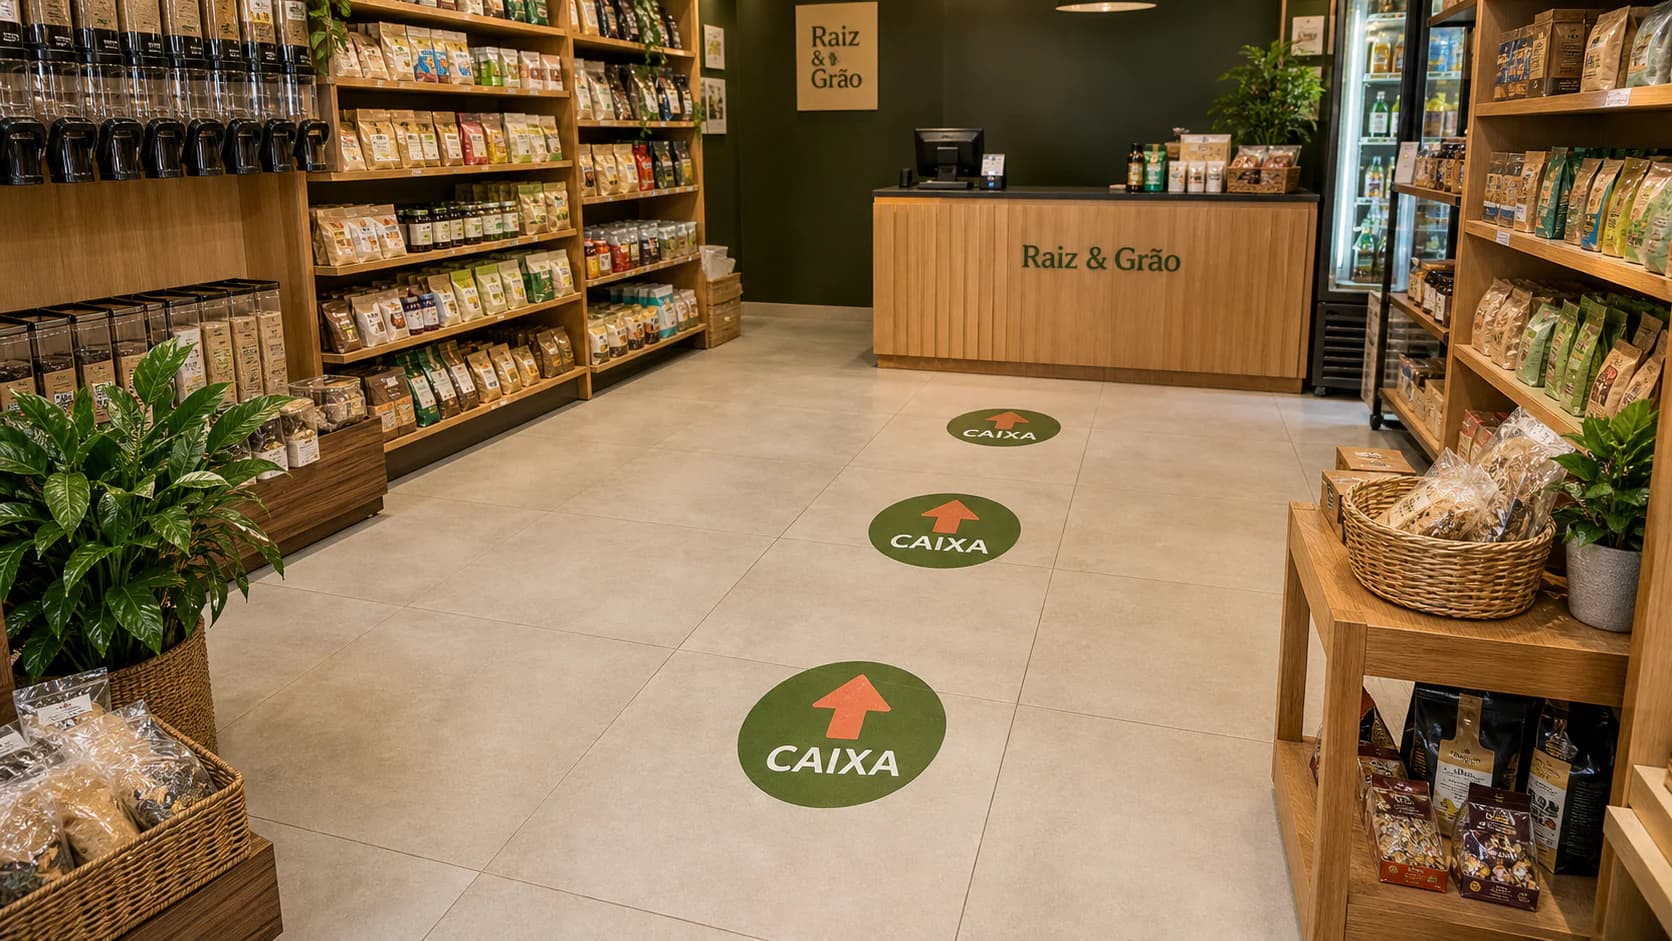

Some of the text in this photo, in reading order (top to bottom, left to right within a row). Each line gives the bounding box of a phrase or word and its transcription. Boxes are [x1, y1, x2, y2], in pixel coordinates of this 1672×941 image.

[812, 26, 860, 47] Raiz
[811, 50, 825, 66] &
[811, 68, 863, 89] Grão
[1022, 245, 1181, 272] Raiz & Grão
[963, 429, 1036, 441] CAIXA
[890, 534, 988, 555] CAIXA
[766, 745, 900, 777] CAIXA
